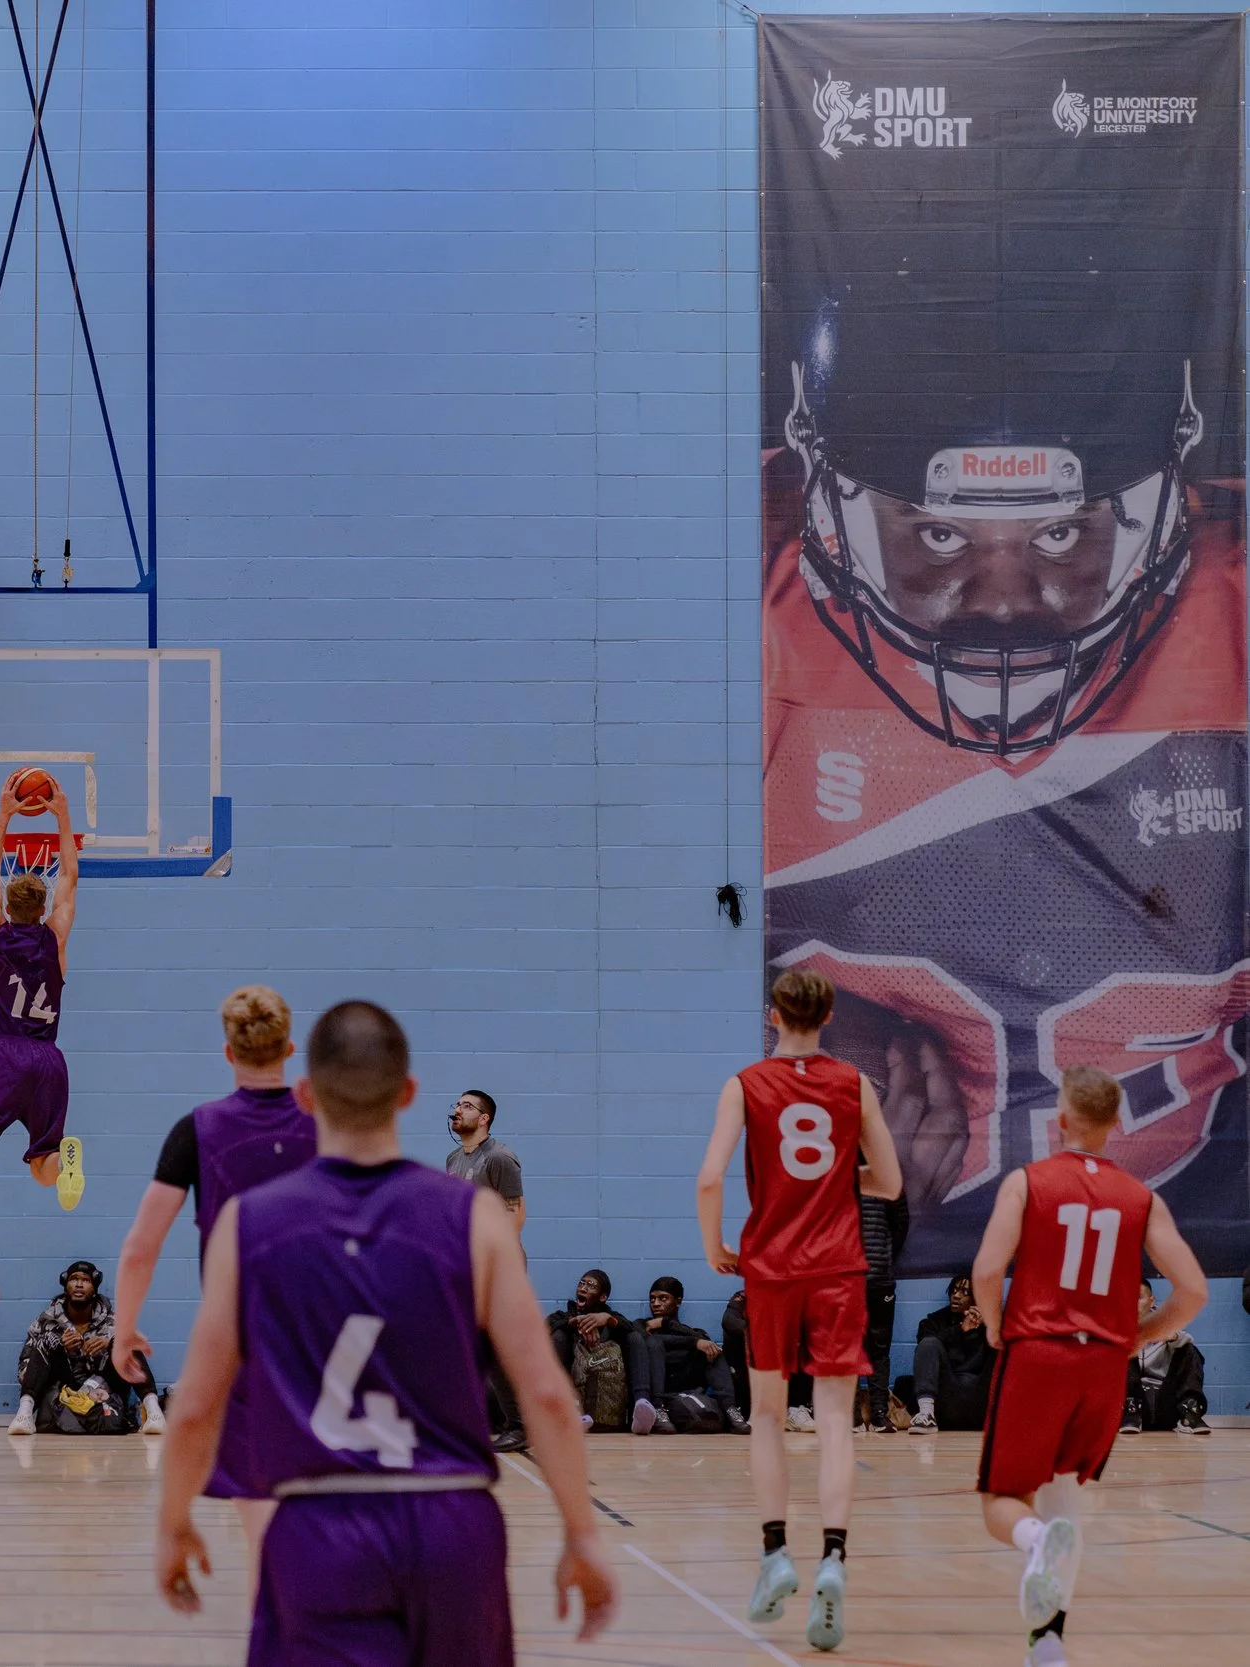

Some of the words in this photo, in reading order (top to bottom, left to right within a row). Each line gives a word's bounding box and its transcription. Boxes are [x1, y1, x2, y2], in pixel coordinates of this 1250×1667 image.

[875, 87, 946, 117] DMU
[1093, 97, 1114, 109] DE
[1117, 97, 1198, 109] MONTFORT
[1093, 109, 1198, 124] UNIVERSITY
[873, 117, 973, 148] SPORT
[1093, 124, 1147, 133] LEICESTER
[962, 453, 1047, 477] Riddell
[1174, 787, 1227, 815] DMU
[1176, 807, 1244, 835] SPORT
[8, 973, 58, 1025] 14
[777, 1101, 836, 1181] 8
[1057, 1203, 1122, 1297] 11
[309, 1313, 419, 1469] 4
